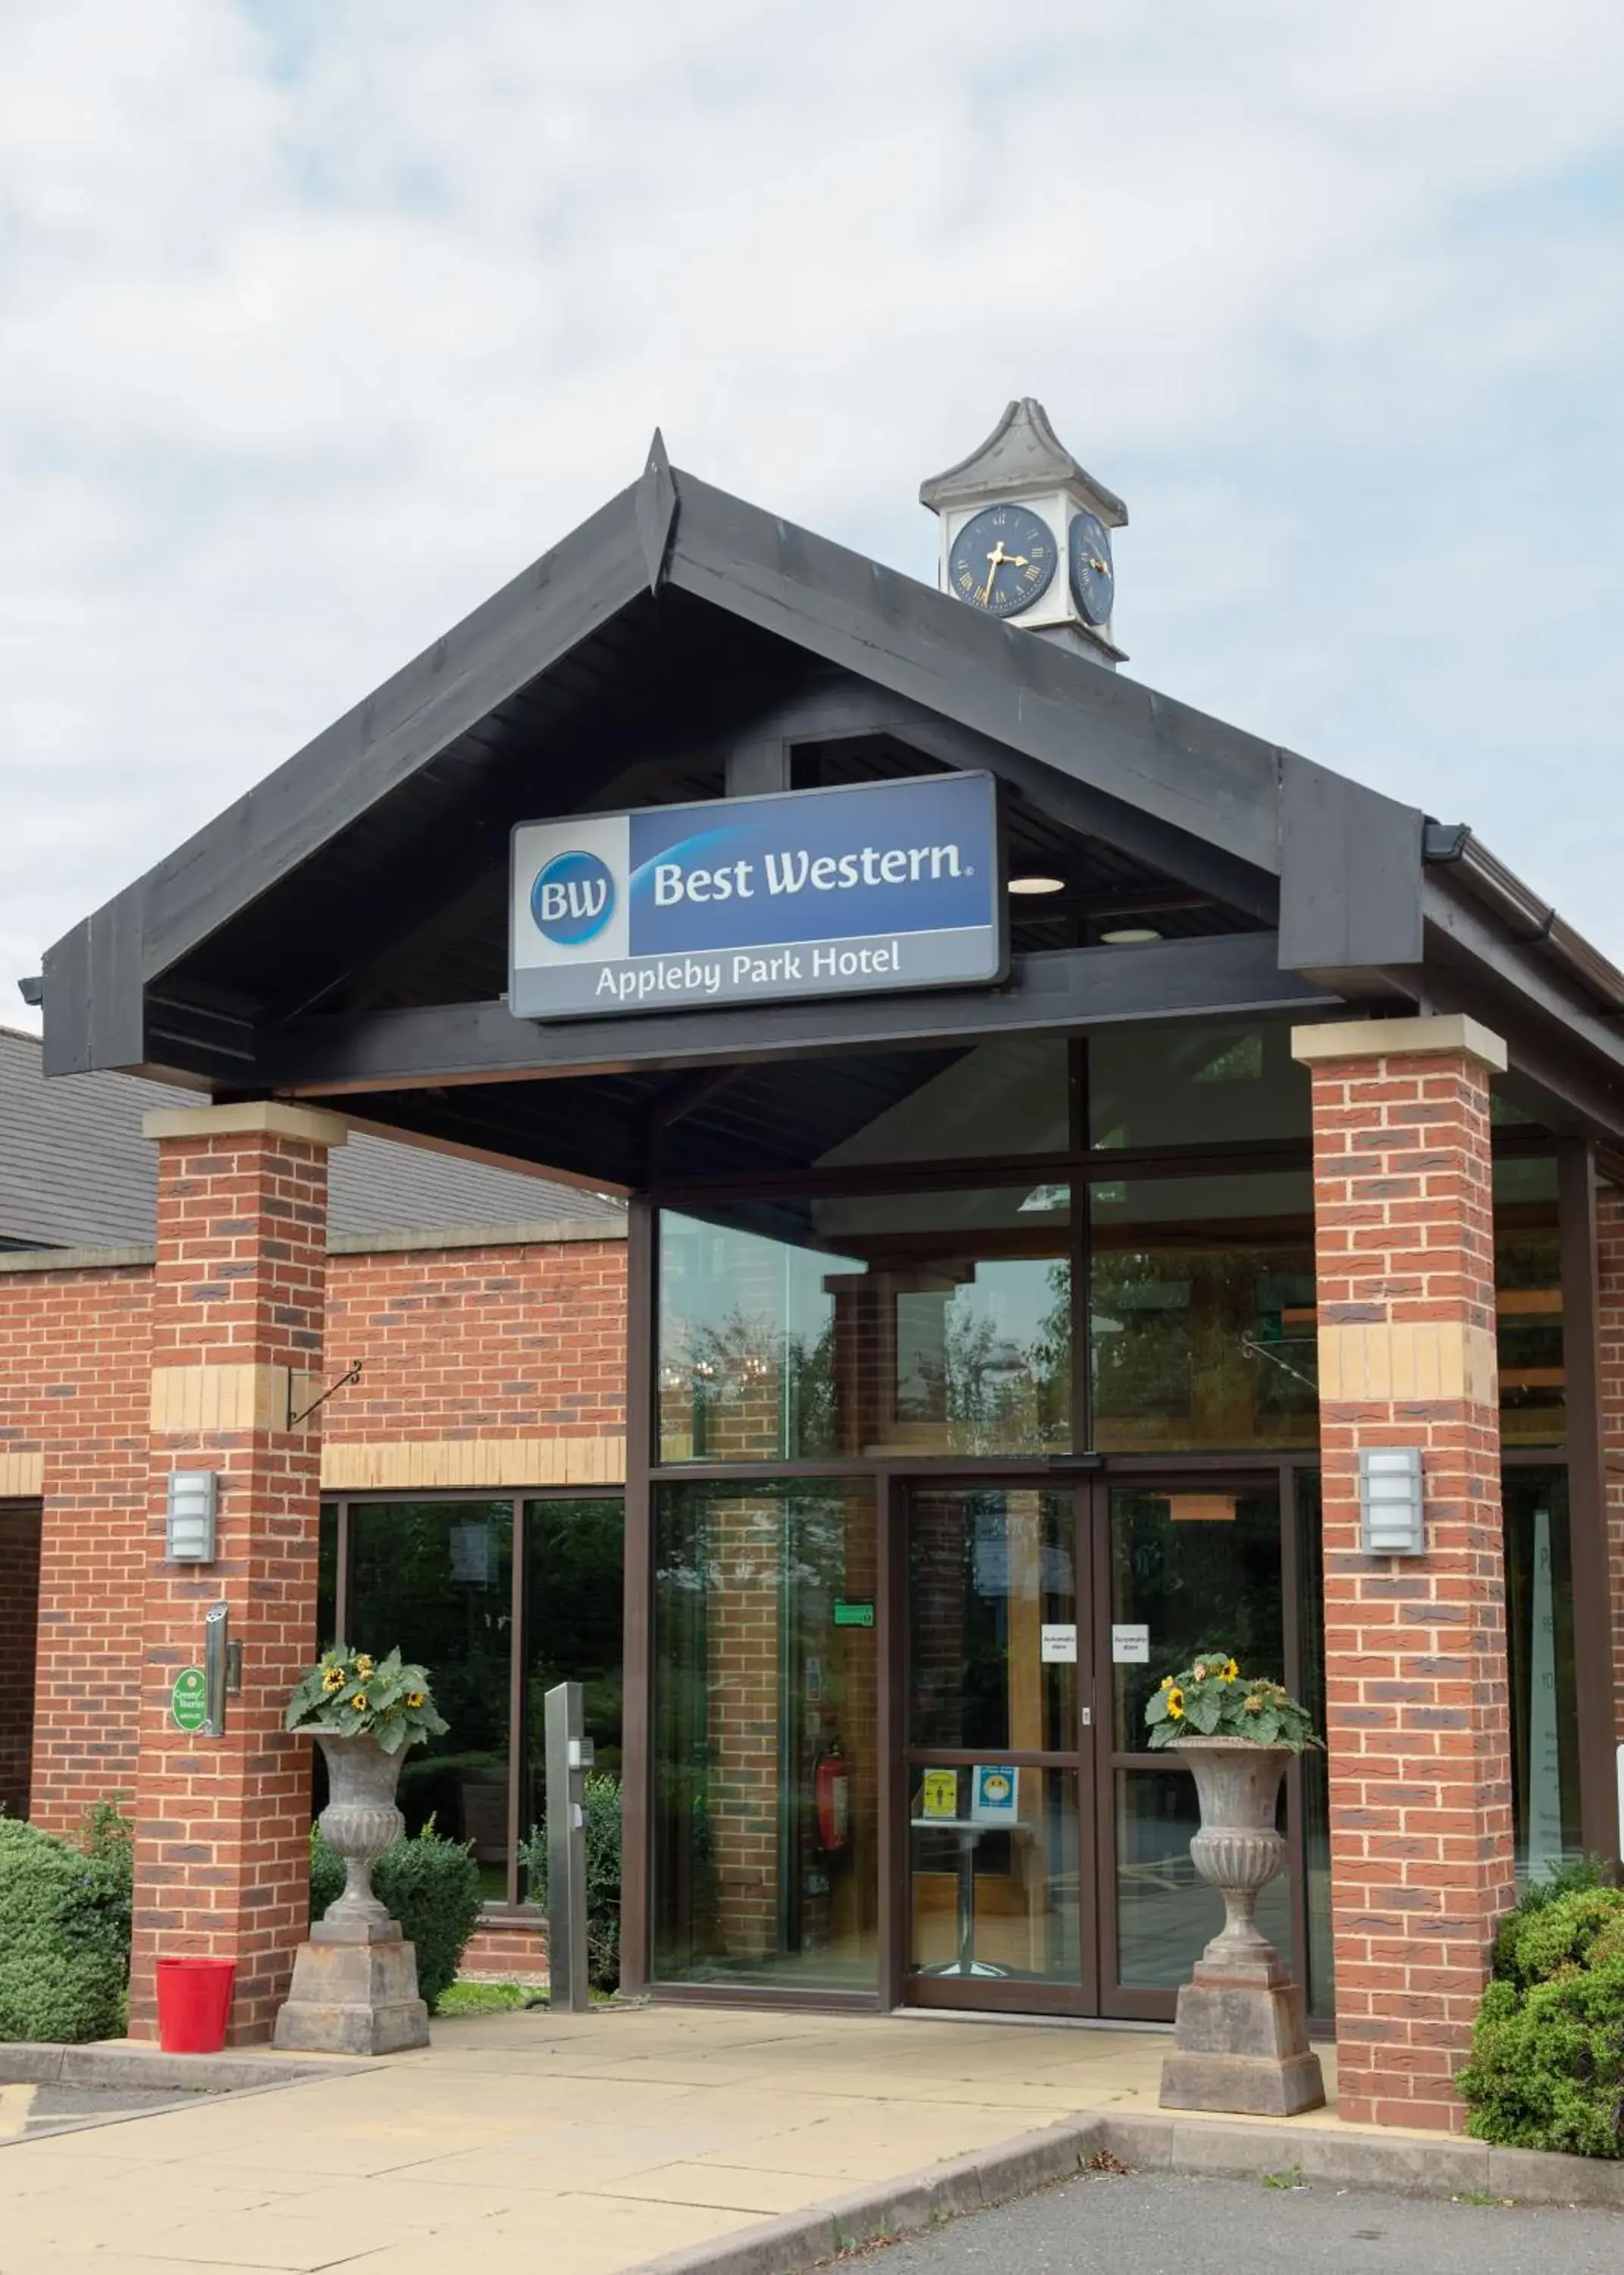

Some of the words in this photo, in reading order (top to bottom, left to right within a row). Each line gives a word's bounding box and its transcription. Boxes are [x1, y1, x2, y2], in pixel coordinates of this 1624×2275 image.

[541, 877, 607, 921] BW
[654, 860, 754, 906] Best
[594, 959, 721, 1000] Appleby
[732, 949, 802, 983] Park
[812, 940, 900, 977] Hotel
